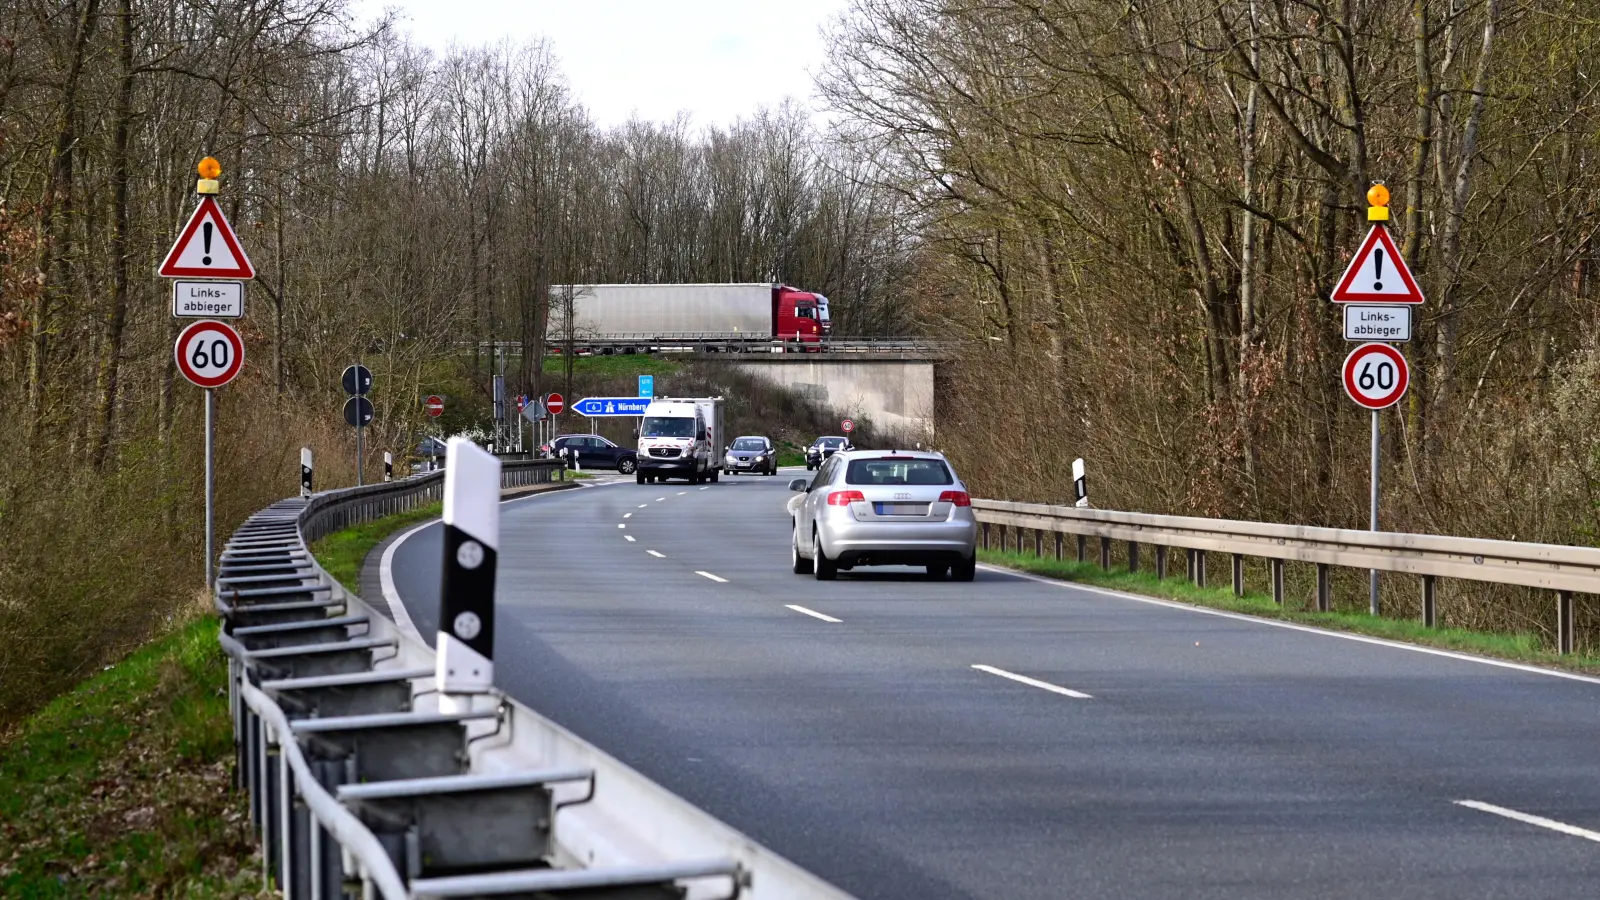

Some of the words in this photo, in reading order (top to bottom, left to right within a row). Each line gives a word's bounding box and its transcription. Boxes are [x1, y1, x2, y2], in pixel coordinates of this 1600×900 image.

[190, 287, 227, 298] Links-
[184, 302, 232, 314] abbieger
[1360, 311, 1396, 322] Links-
[1354, 326, 1401, 337] abbieger
[192, 340, 228, 368] 60
[1359, 362, 1394, 390] 60
[618, 402, 646, 412] Nürnberg
